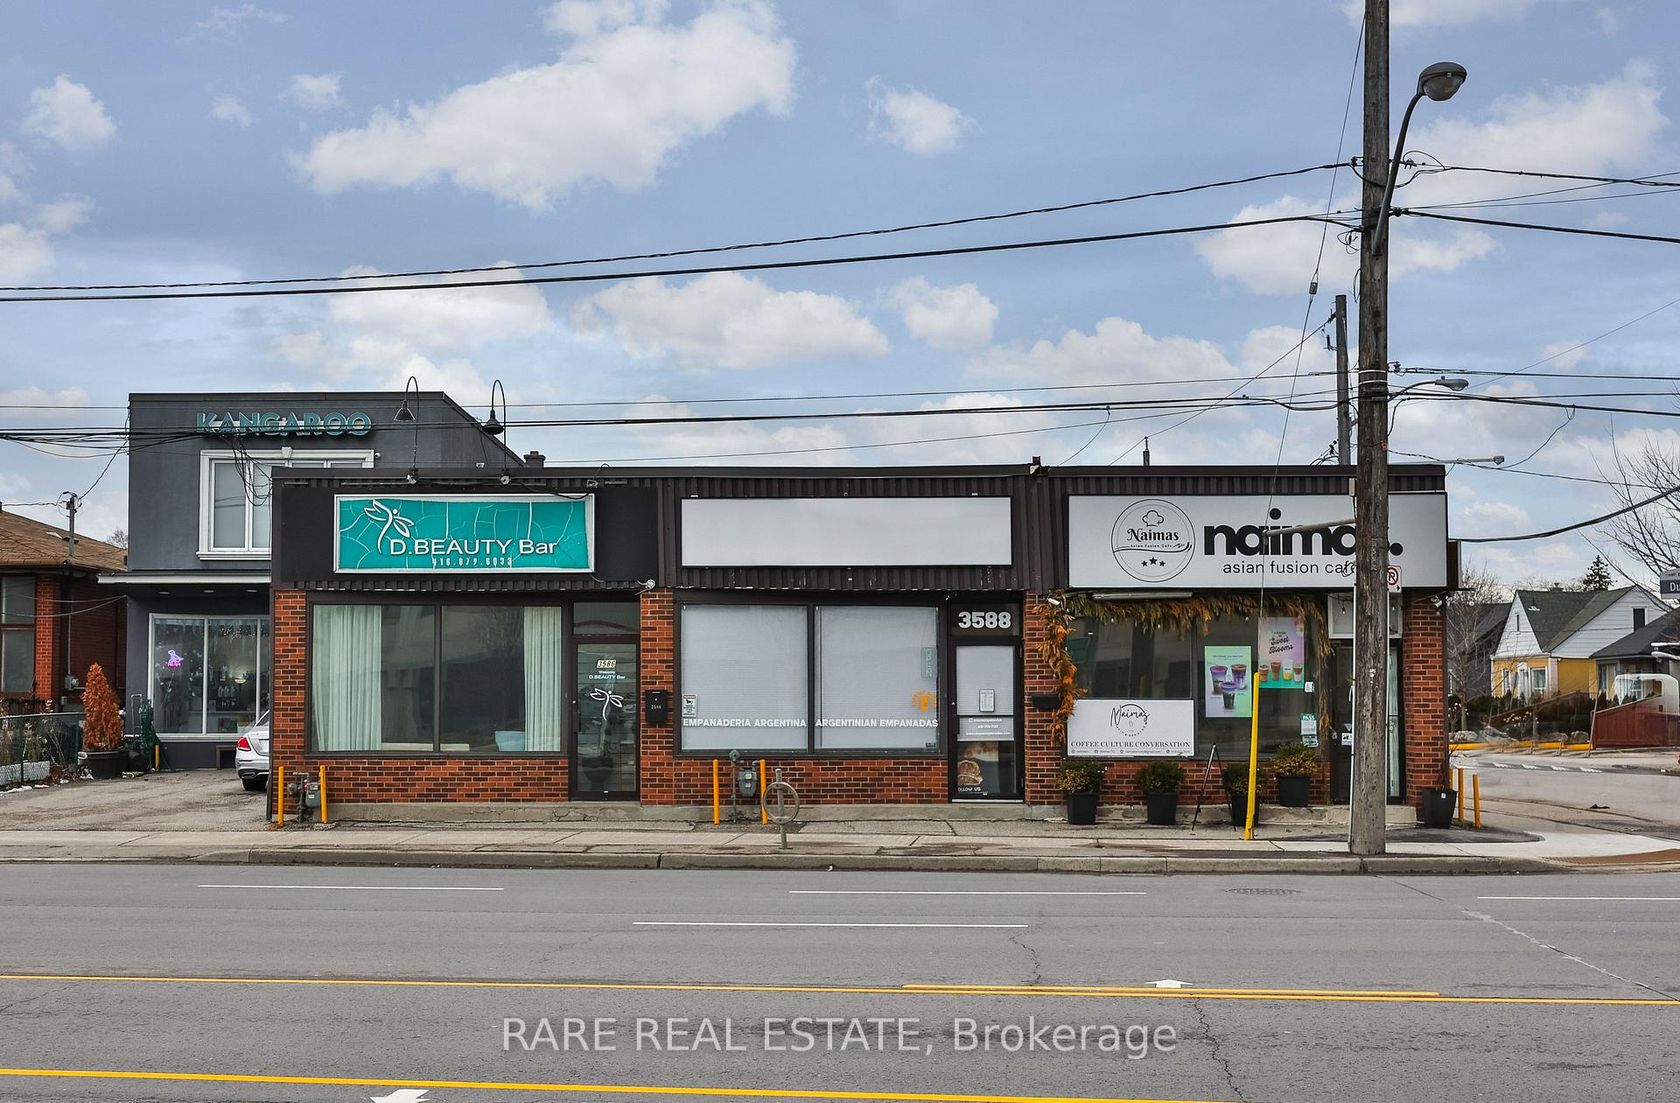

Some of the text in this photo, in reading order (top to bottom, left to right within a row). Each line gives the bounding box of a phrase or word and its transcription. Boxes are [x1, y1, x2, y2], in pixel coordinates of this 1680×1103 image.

[196, 411, 372, 437] KANGAROO
[1127, 528, 1179, 542] Naimas
[390, 539, 557, 555] D.BEAUTY Bar
[1223, 560, 1264, 573] asian
[1270, 560, 1319, 573] fusion
[958, 611, 1012, 629] 3588
[683, 719, 807, 727] EMPANADERIA ARGENTINA
[815, 719, 939, 727] ARGENTINIAN EMPANADAS
